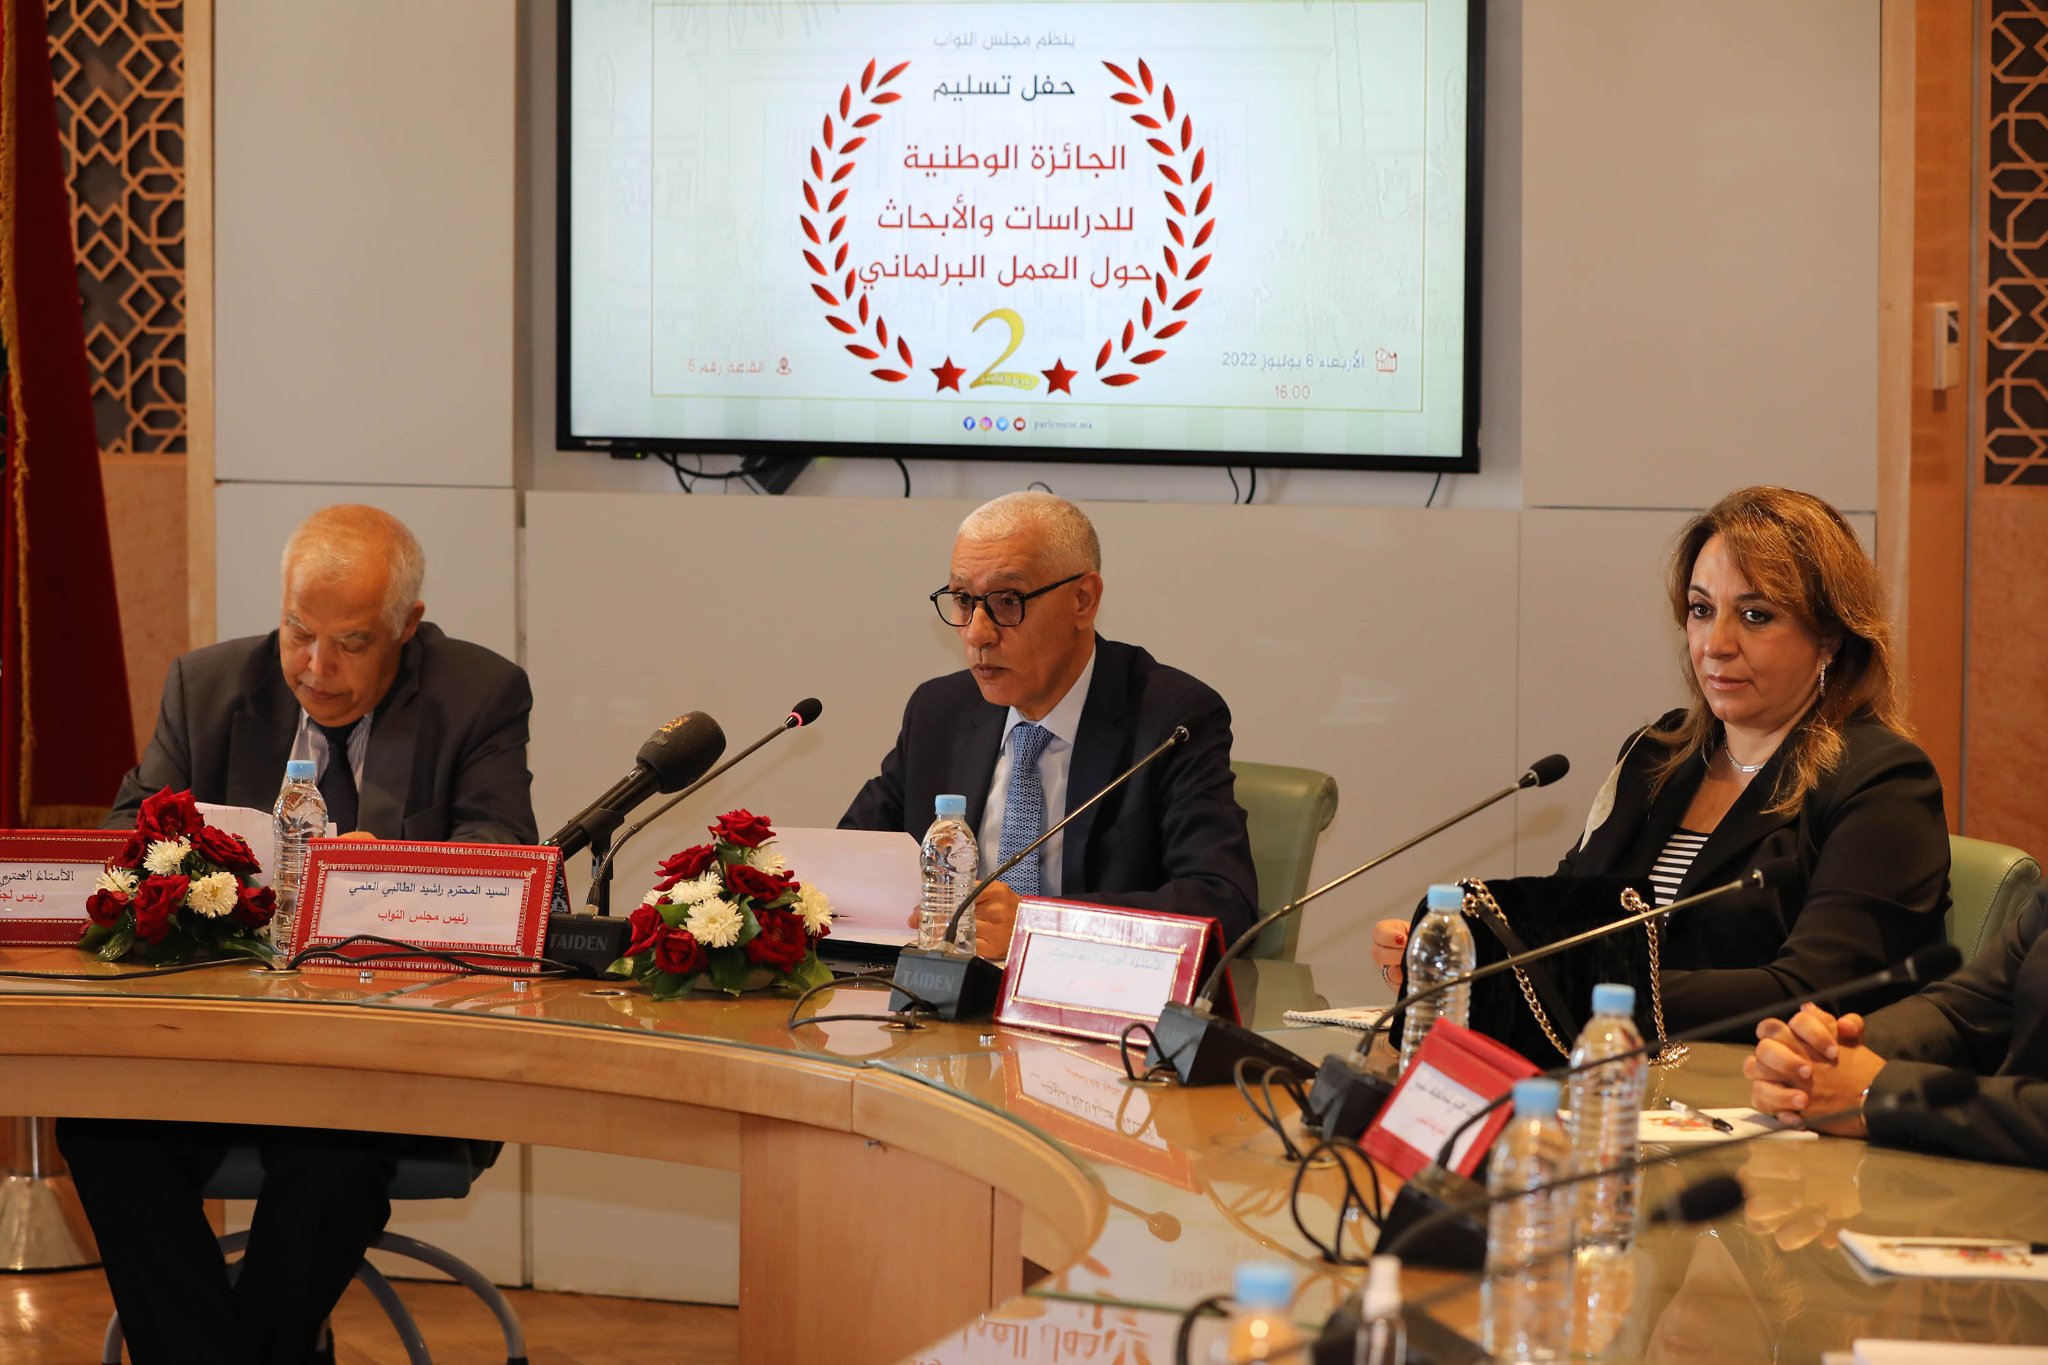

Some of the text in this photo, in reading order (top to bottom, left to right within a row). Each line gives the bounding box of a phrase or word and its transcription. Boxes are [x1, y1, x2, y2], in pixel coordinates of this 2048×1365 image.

[933, 30, 1076, 51] ينظم مجلس النواب
[933, 74, 1075, 102] حفل تسليم
[904, 142, 1126, 178] الجائزة الوطنية
[877, 194, 1134, 238] للدراسات والأبحاث
[858, 254, 1152, 290] حول العمل البرلماني
[1221, 349, 1365, 373] الأربعاء 6 يوليوز 2022
[16, 890, 45, 902] رئيس
[348, 881, 510, 899] السيد المحترم راشيد الطالبي العلمي
[377, 909, 469, 925] رئيس مجلس النواب
[549, 933, 609, 951] TAIDEN
[901, 970, 954, 991] TAIDEN
